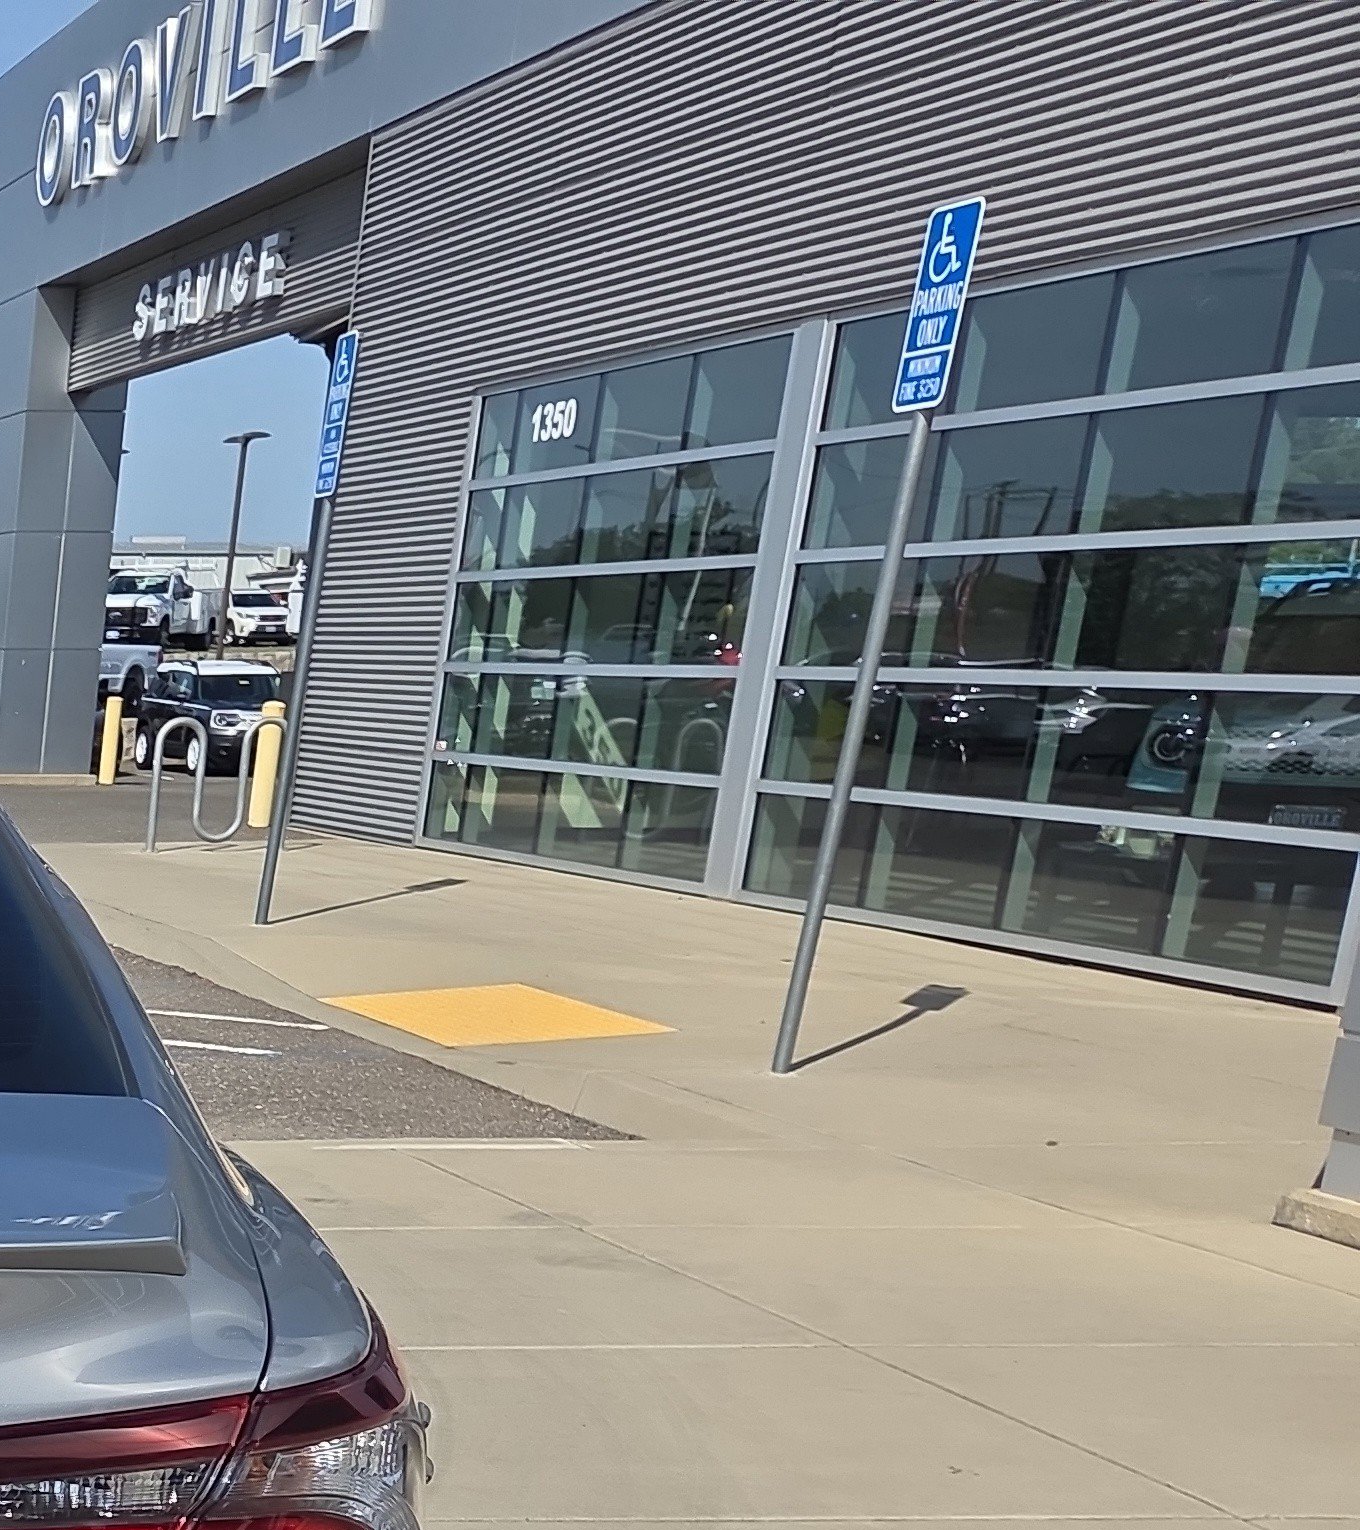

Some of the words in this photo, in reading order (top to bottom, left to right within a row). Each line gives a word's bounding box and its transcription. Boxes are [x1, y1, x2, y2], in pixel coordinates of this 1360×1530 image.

[133, 233, 285, 341] SERVICE
[913, 281, 964, 317] PARKING
[917, 315, 948, 347] ONLY
[532, 398, 578, 443] 1350
